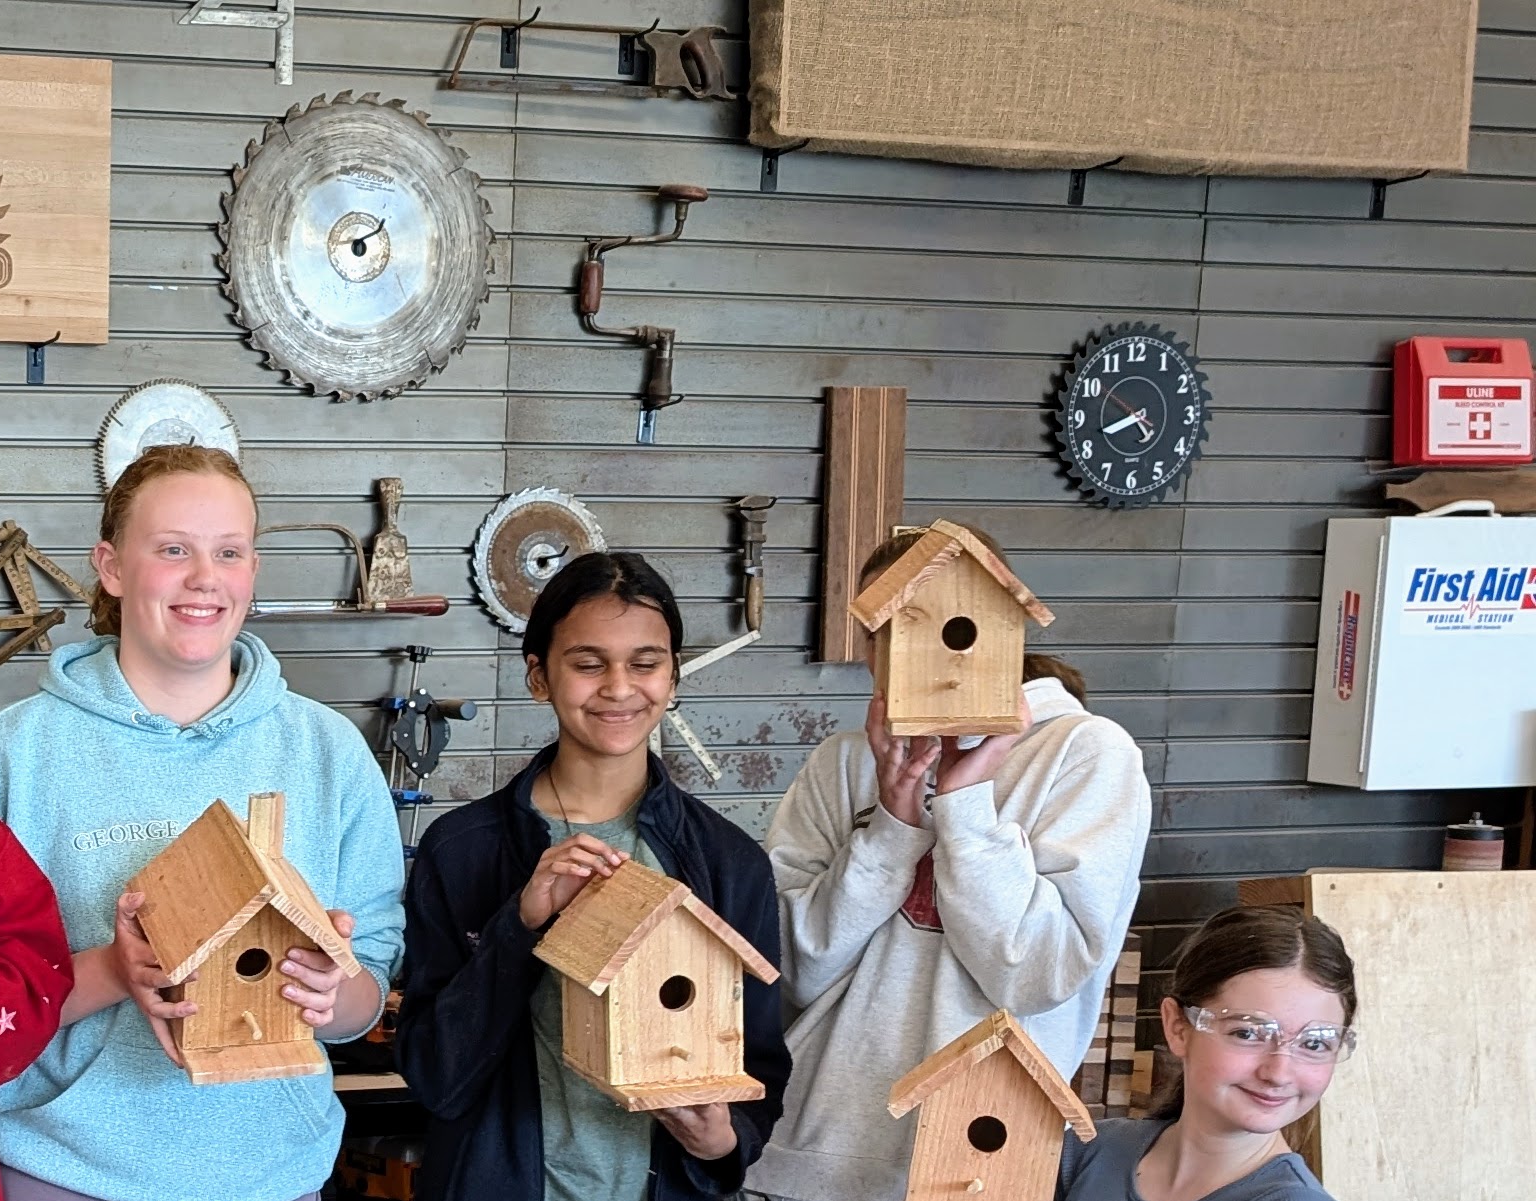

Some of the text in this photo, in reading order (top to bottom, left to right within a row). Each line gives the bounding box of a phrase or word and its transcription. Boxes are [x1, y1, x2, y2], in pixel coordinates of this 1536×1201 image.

[1126, 343, 1147, 362] 12
[1158, 352, 1168, 371] 1
[1102, 353, 1120, 373] 11
[1081, 377, 1101, 398] 10
[1177, 374, 1189, 394] 2
[1466, 387, 1495, 398] ULINE
[1074, 409, 1085, 429] 9
[1183, 405, 1195, 425] 3
[1081, 440, 1093, 459] 8
[1173, 437, 1185, 456] 4
[1101, 462, 1113, 482] 7
[1125, 470, 1137, 489] 6
[1152, 461, 1164, 480] 5
[1406, 567, 1529, 602] First Aid
[1426, 613, 1514, 624] MEDICAL STATION
[73, 821, 180, 851] GEORGE
